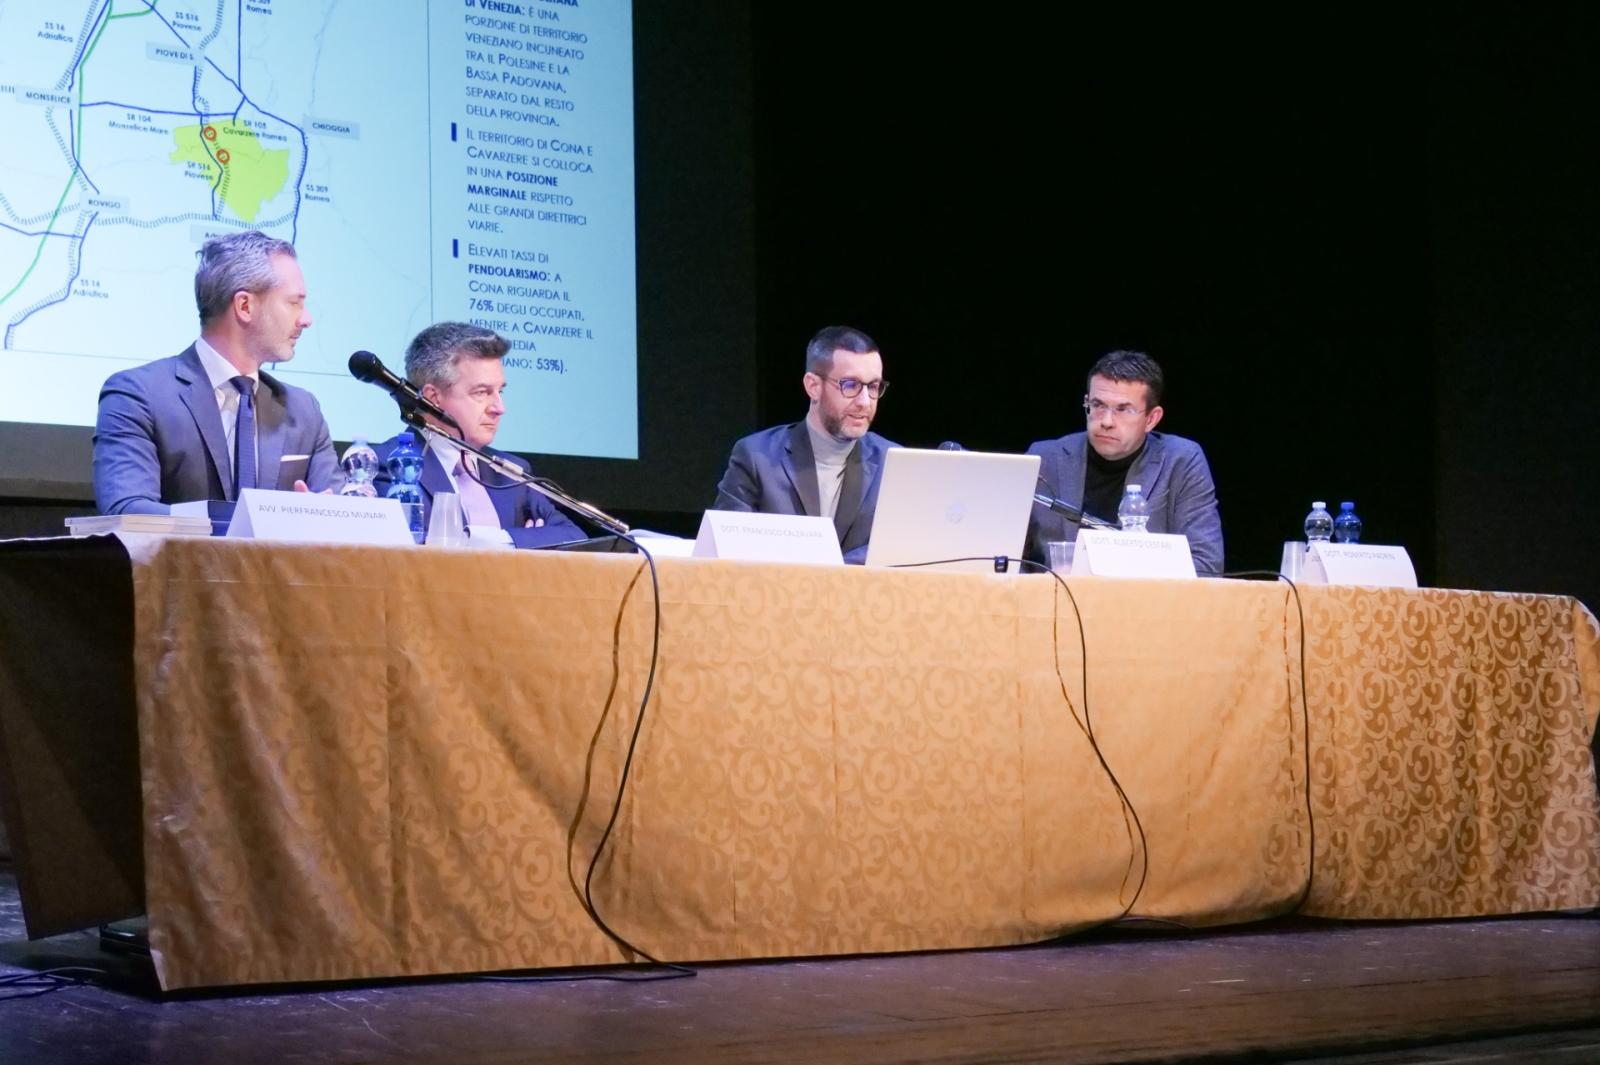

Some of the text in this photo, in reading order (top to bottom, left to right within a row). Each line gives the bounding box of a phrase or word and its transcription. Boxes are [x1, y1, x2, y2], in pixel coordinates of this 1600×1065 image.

[246, 4, 272, 15] Romea
[480, 0, 526, 16] VENEZIA:
[537, 10, 560, 21] UNA
[172, 20, 202, 31] Piovese
[464, 14, 588, 44] PORZIONE DI TERRITORIO
[37, 31, 73, 43] Adriatica
[465, 31, 585, 60] VENEZIANO INCUNEATO
[155, 48, 179, 59] PIOVE
[180, 51, 189, 60] DI
[466, 50, 570, 76] TRA IL POLESINE E LA
[466, 66, 499, 82] BASSA
[25, 91, 71, 104] MONSELICE
[466, 86, 575, 112] SEPARATO DAL RESTO
[466, 103, 560, 127] DELLA PROVINCIA.
[108, 120, 169, 135] Monselice Mare
[222, 126, 287, 142] Cavarzere Romea
[312, 122, 350, 133] CHIOGGIA
[466, 128, 593, 157] IL TERRITORIO DI CONA E
[467, 145, 593, 174] CAVARZERE SI COLLOCA
[184, 170, 213, 180] Piovese
[466, 165, 559, 187] IN UNA POSIZIONE
[88, 199, 121, 209] ROVIGO
[304, 193, 330, 203] Romea
[467, 183, 574, 207] MARGINALE RISPETTO
[467, 202, 587, 226] ALLE GRANDI DIRETTRICI
[467, 219, 504, 234] VIARIE.
[468, 243, 549, 264] ELEVATI TASSI DI
[468, 263, 562, 283] PENDOLARISMO: A
[468, 280, 571, 302] CONA RIGUARDA IL
[469, 298, 495, 313] 76%
[496, 302, 527, 316] DEGLI
[469, 318, 595, 340] MENTRE A CAVARZERE IL
[512, 339, 537, 352] EDIA
[536, 357, 568, 375] 53%).
[280, 505, 350, 518] PIERFRANCESCO
